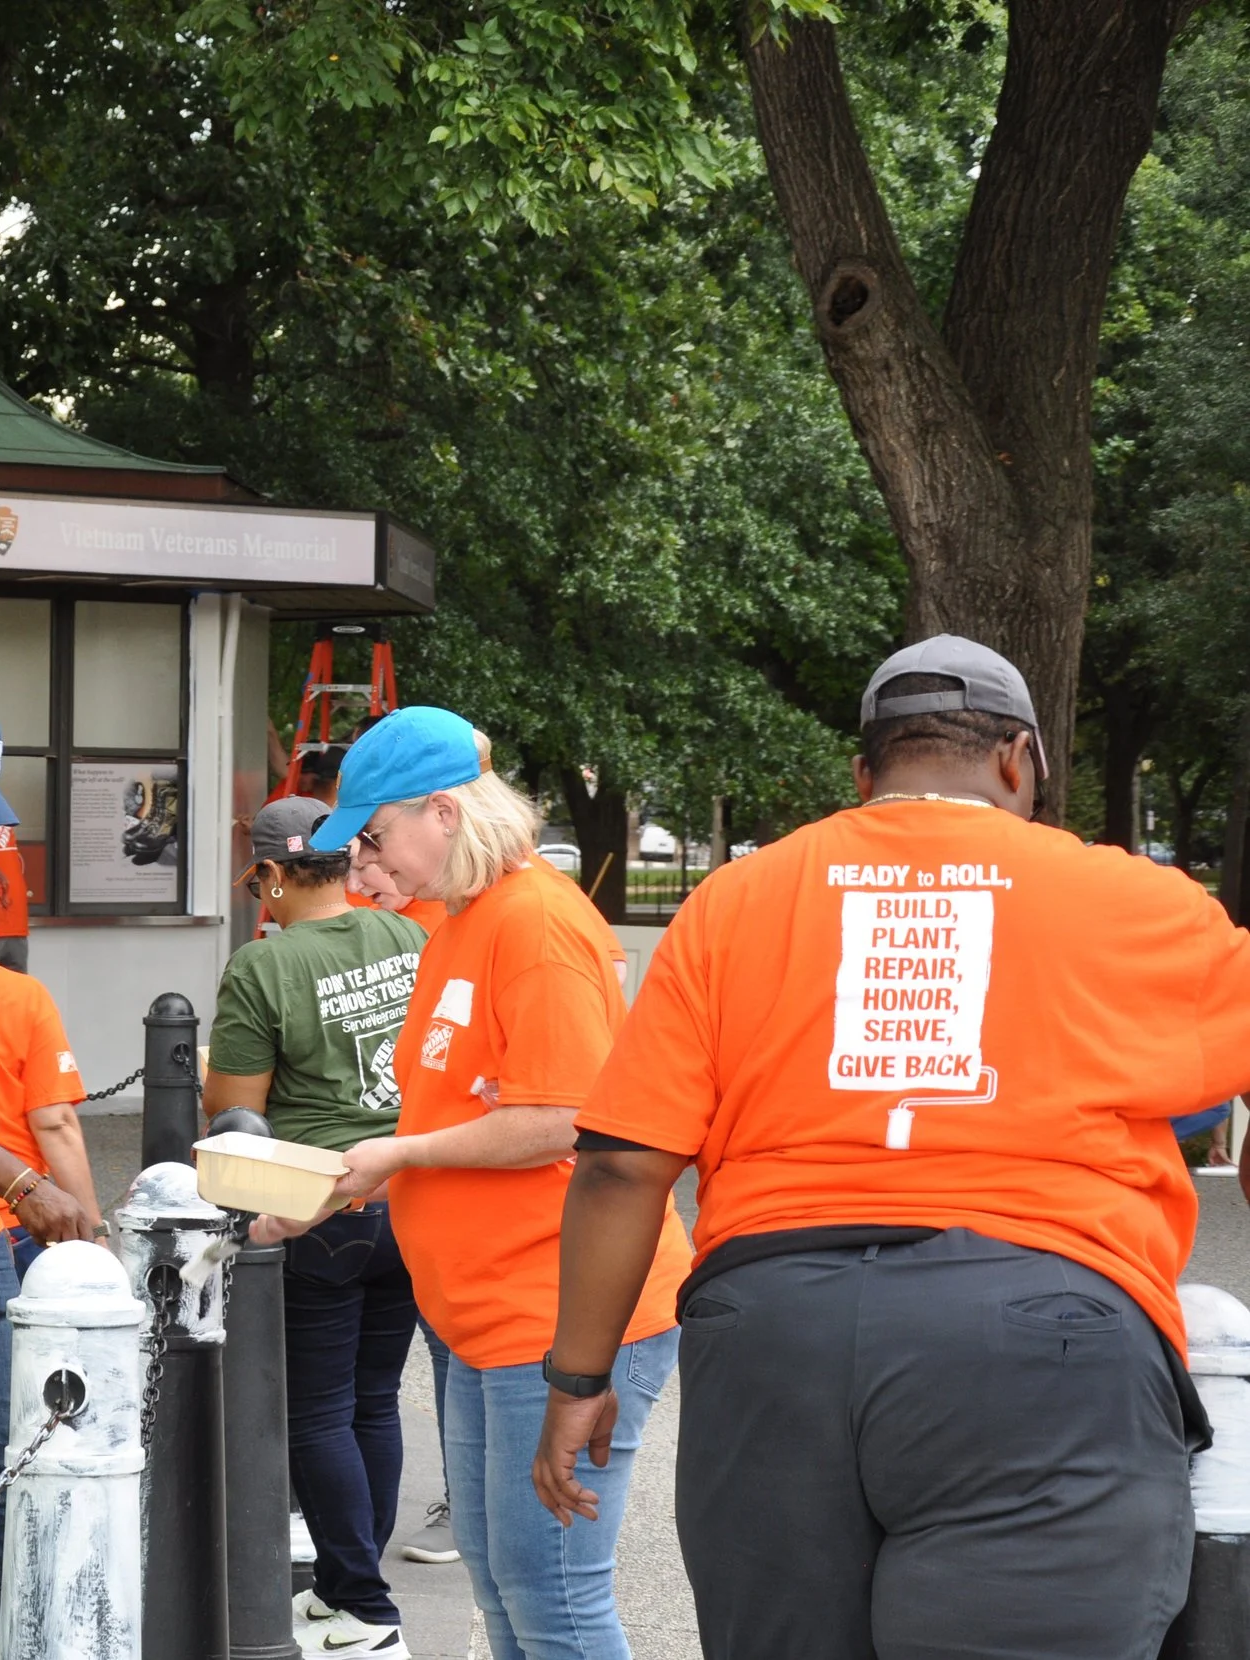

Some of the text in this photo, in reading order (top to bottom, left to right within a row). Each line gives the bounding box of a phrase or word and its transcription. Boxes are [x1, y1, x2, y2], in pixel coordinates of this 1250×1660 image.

[60, 521, 337, 561] Vietnam Veterans Memorial
[827, 864, 1012, 889] READY to ROLL,
[876, 899, 958, 923] BUILD,
[871, 927, 960, 953] PLANT,
[864, 957, 962, 983] REPAIR,
[316, 977, 346, 998] JOIN
[863, 988, 959, 1014] HONOR,
[863, 1019, 953, 1046] SERVE,
[837, 1054, 972, 1078] GIVE BACK
